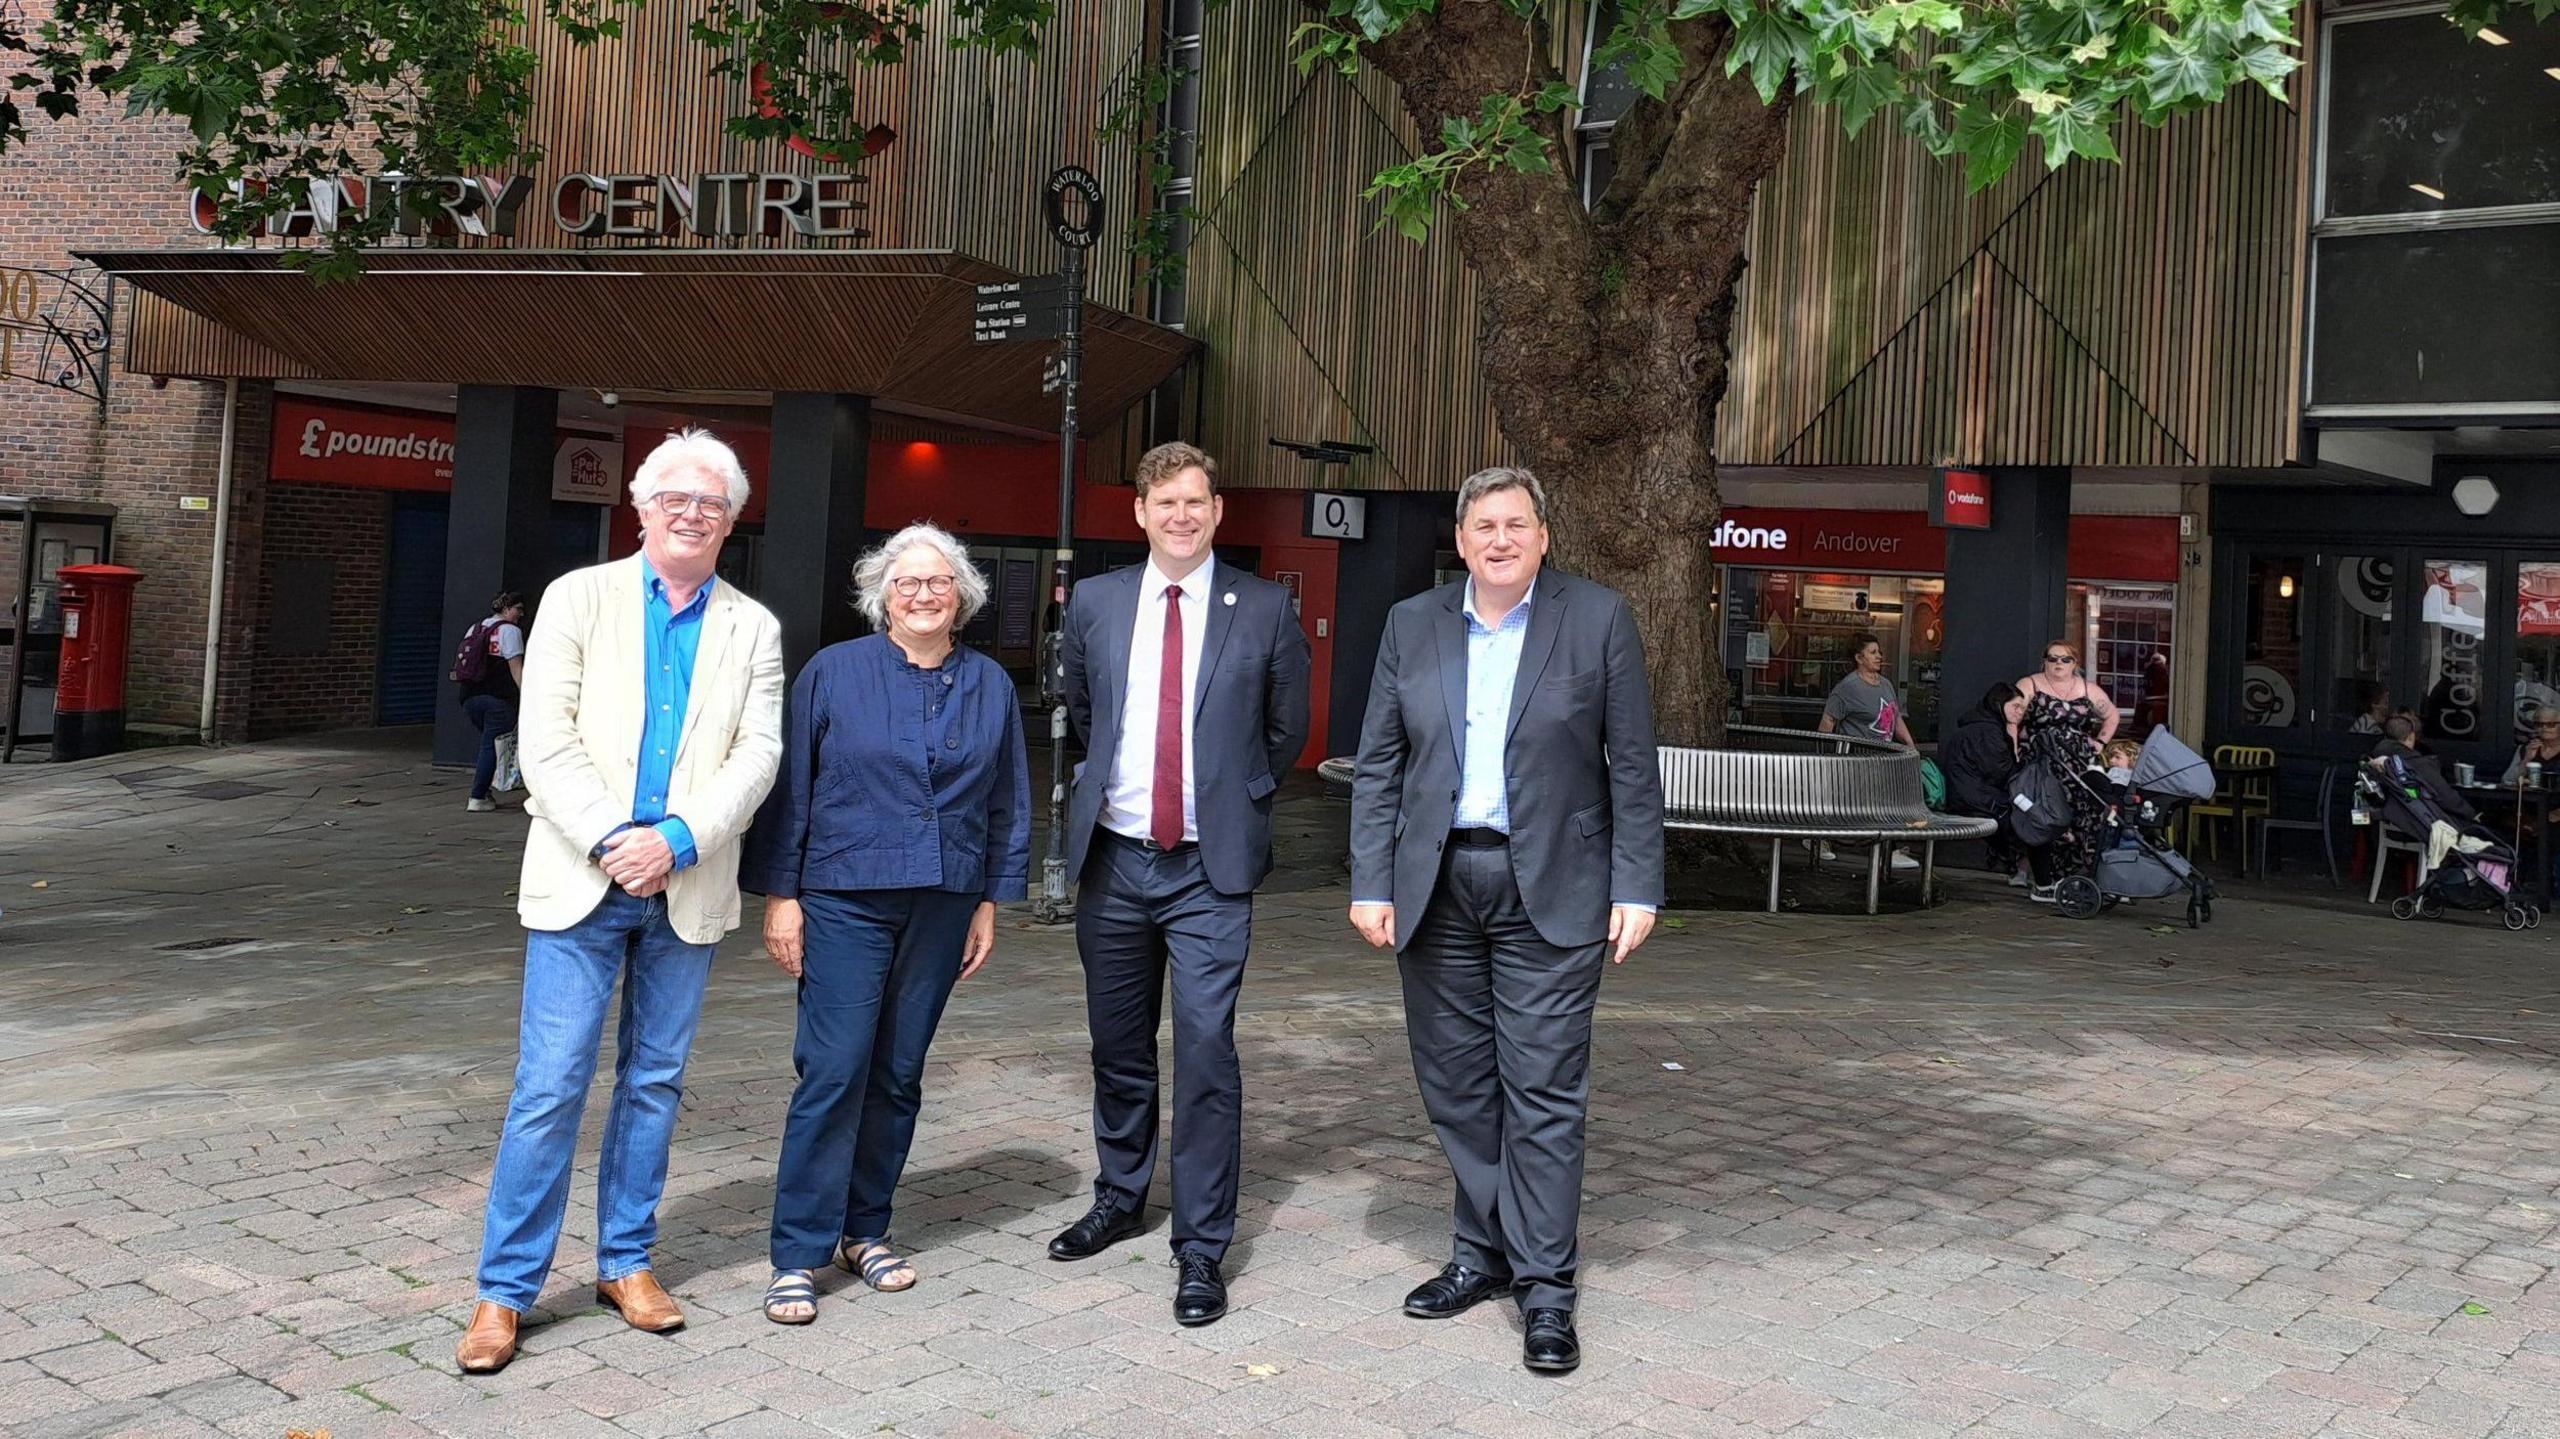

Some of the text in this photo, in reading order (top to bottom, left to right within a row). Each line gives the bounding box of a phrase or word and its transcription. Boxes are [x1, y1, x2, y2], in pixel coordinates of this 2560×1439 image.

[1051, 169, 1099, 201] WATERLOO
[553, 172, 866, 237] CENTRE
[1059, 225, 1091, 245] COURT
[0, 268, 38, 321] O
[977, 282, 1020, 294] Waterloo Court
[976, 300, 1020, 312] Leisure Centre
[975, 318, 1011, 329] Bus Station
[975, 329, 1007, 341] Taxi Rank
[578, 456, 599, 472] Pet
[577, 471, 598, 484] Hut
[1957, 492, 1985, 505] vodafone
[1325, 498, 1350, 536] O2
[1814, 530, 1901, 553] Andover
